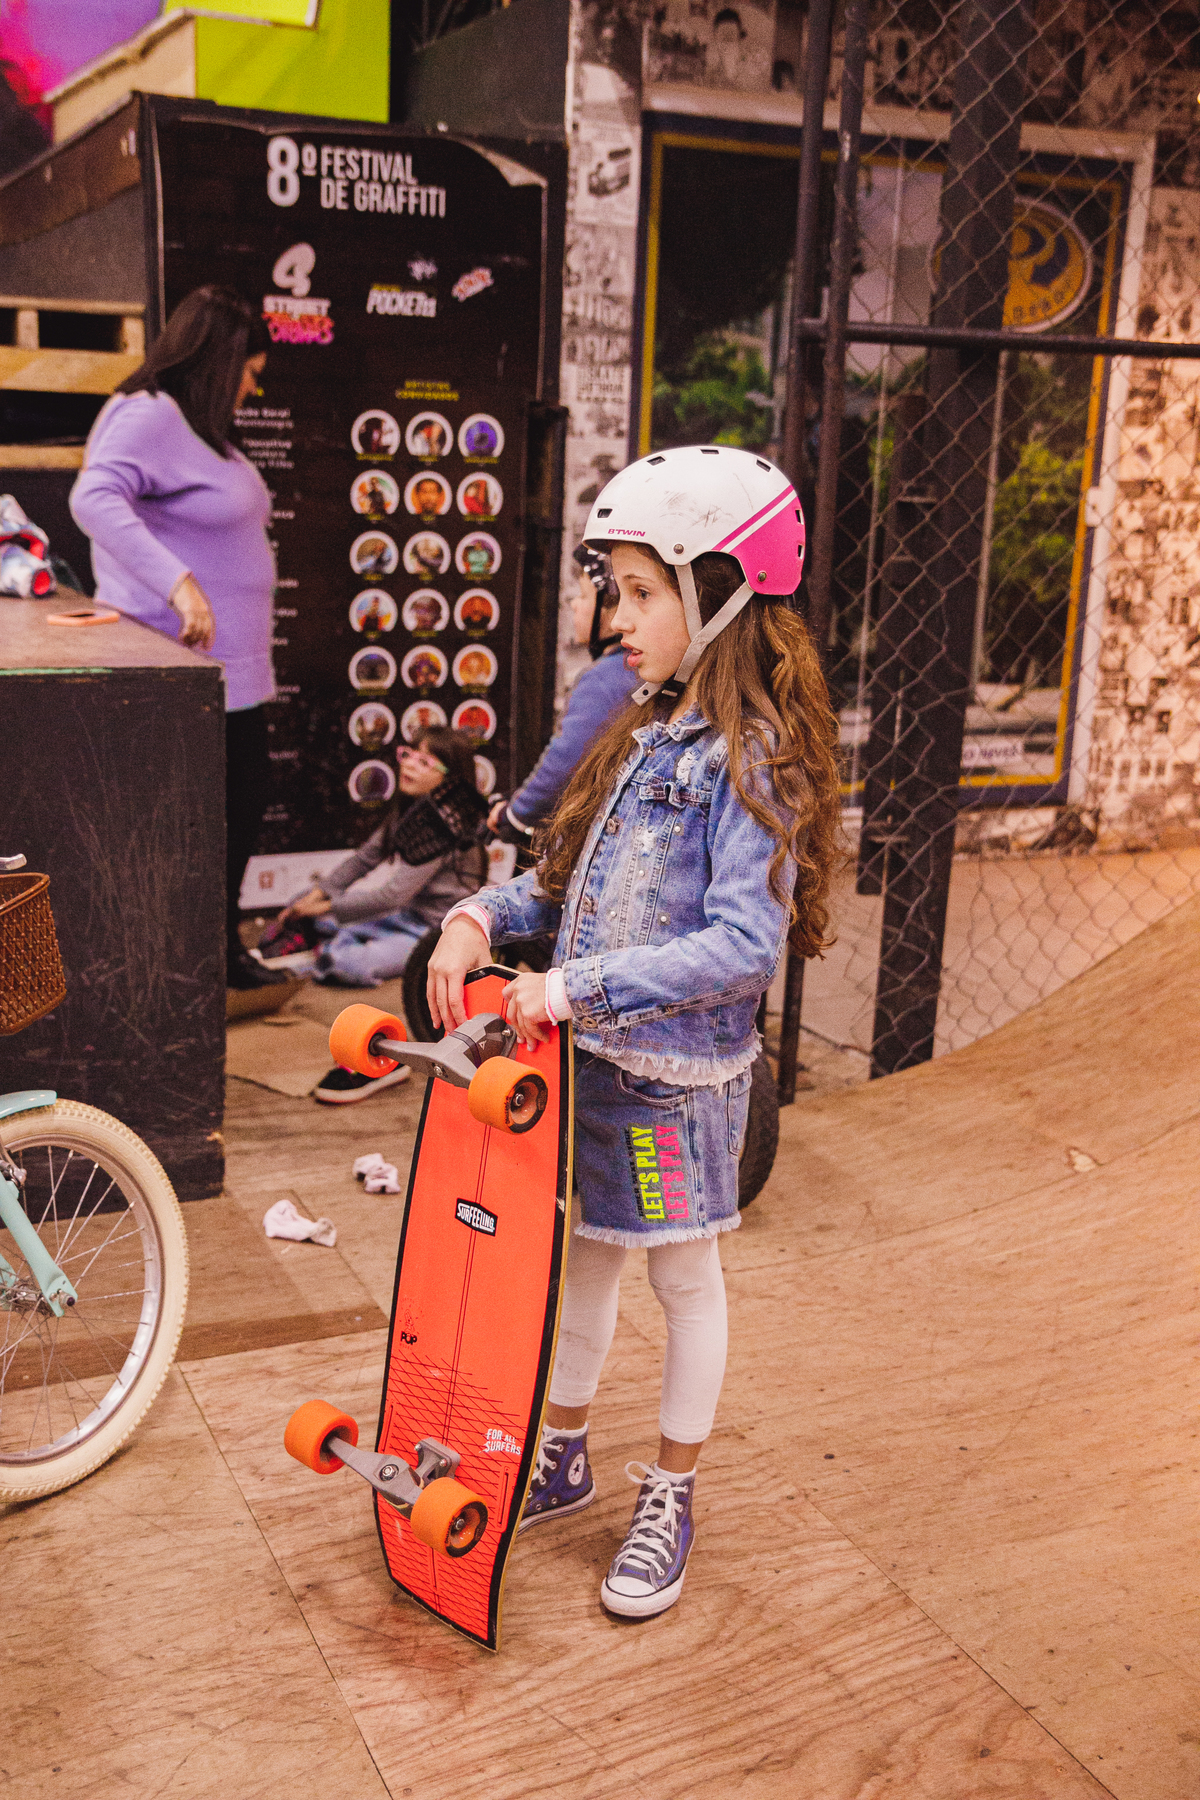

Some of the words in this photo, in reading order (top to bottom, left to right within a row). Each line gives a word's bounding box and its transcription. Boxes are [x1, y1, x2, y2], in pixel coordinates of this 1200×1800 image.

[321, 145, 418, 185] FESTIVAL
[321, 177, 349, 210] DE
[354, 179, 446, 218] GRAFFITI
[631, 1127, 657, 1168] PLAY
[656, 1125, 682, 1167] PLAY
[639, 1172, 665, 1219] LET'S
[662, 1171, 689, 1219] LET'S
[483, 1440, 522, 1455] SURFERS
[486, 1429, 503, 1440] FOR
[504, 1434, 516, 1444] ALL
